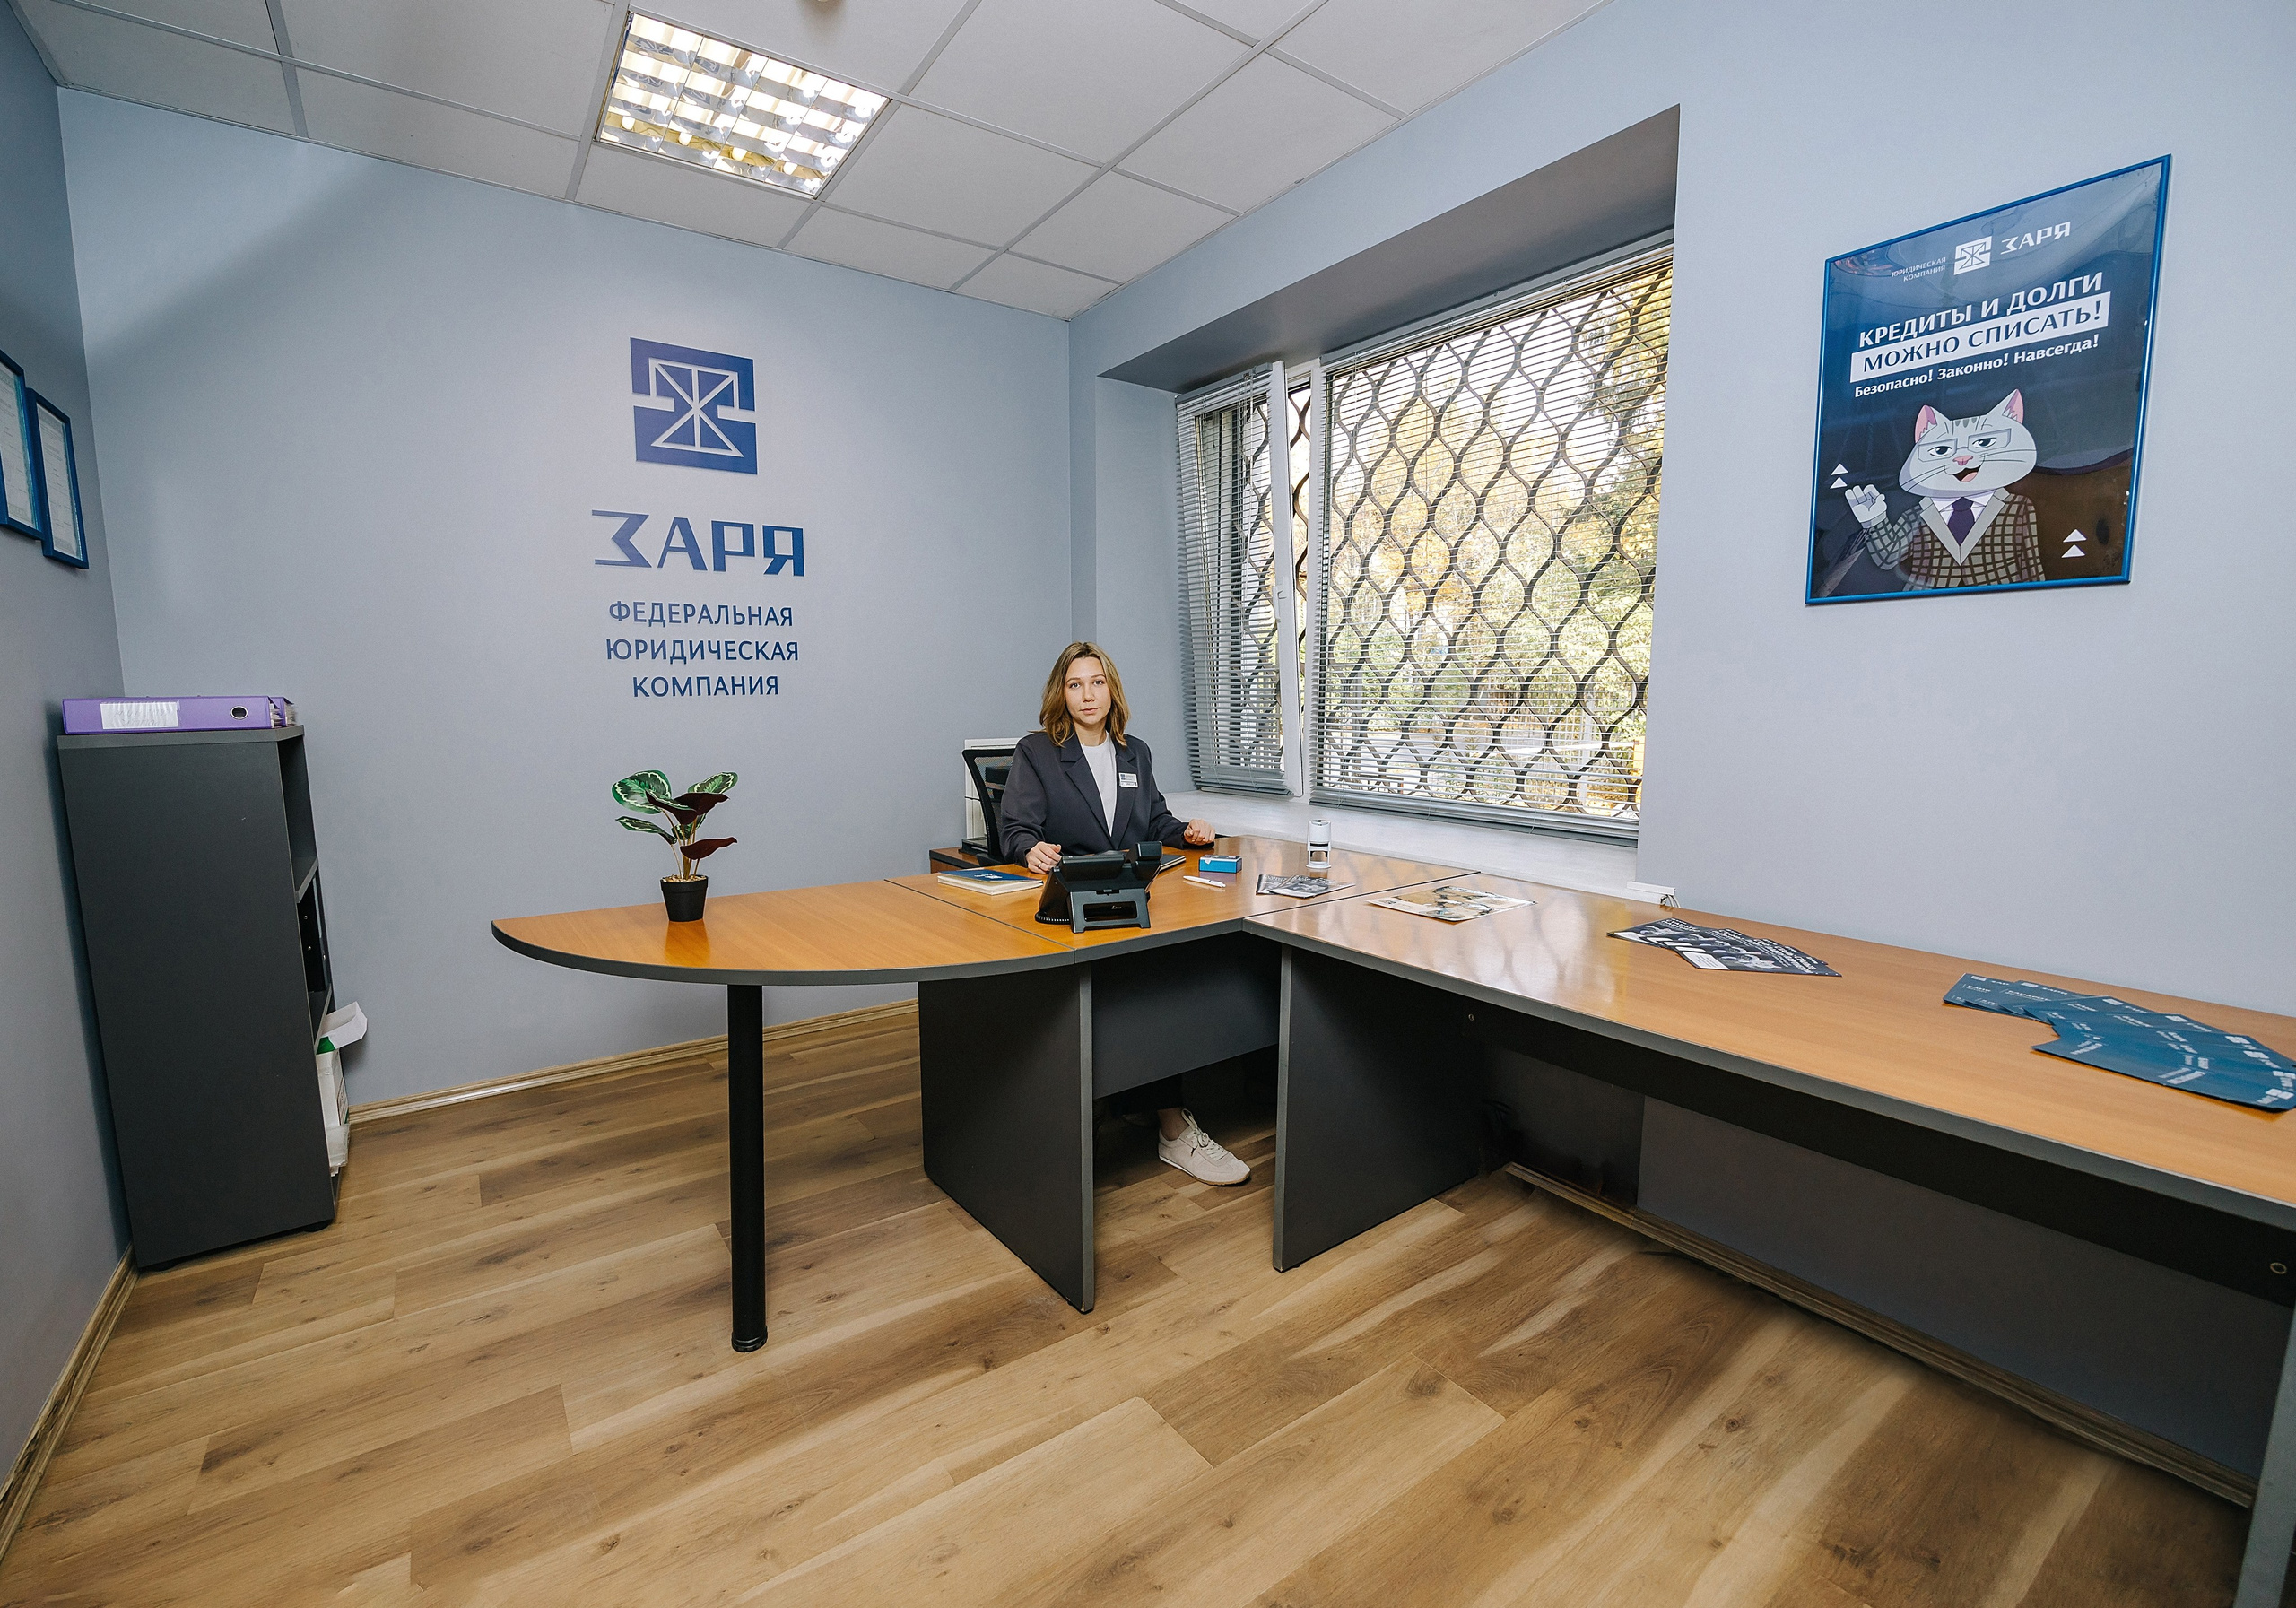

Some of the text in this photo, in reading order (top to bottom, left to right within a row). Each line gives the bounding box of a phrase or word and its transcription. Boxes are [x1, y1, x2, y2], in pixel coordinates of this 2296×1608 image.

[2000, 221, 2071, 255] ЗАРЯ
[1892, 256, 1946, 278] ЮРИДИЧЕСКАЯ
[1903, 265, 1946, 282] КОМПАНИЯ
[1859, 272, 2103, 349] КРЕДИТЫ И ДОЛГИ
[1863, 300, 2102, 373] МОЖНО СПИСАТЬ!
[1854, 334, 2100, 398] Безопасно! Законно! Навсегда!
[591, 508, 805, 577] ЗАРЯ
[608, 600, 794, 628] ФЕДЕРАЛЬНАЯ
[605, 638, 799, 665] ЮРИДИЧЕСКАЯ
[631, 675, 779, 698] КОМПАНИЯ
